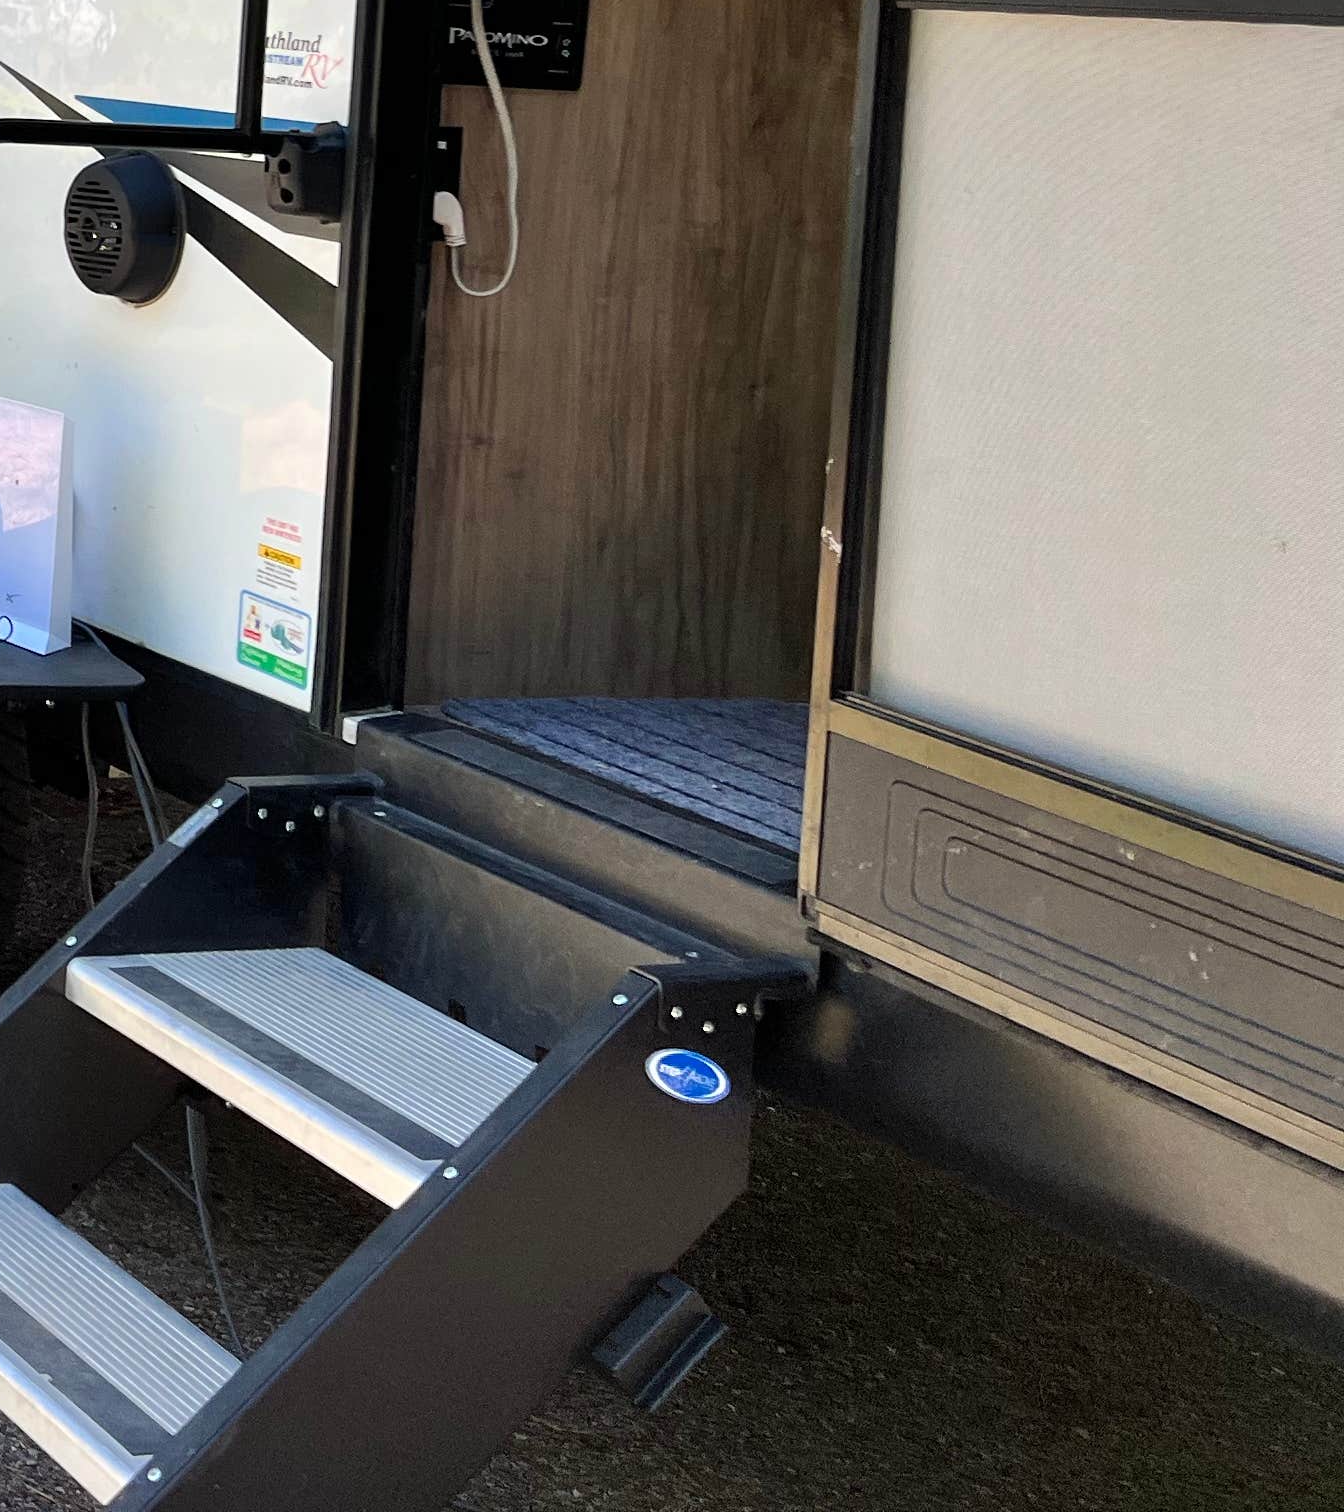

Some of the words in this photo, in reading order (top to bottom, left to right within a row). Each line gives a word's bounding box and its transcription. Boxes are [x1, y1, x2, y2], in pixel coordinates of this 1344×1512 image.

[265, 30, 323, 53] thland
[448, 26, 549, 49] PAOMINO
[301, 53, 345, 89] RV
